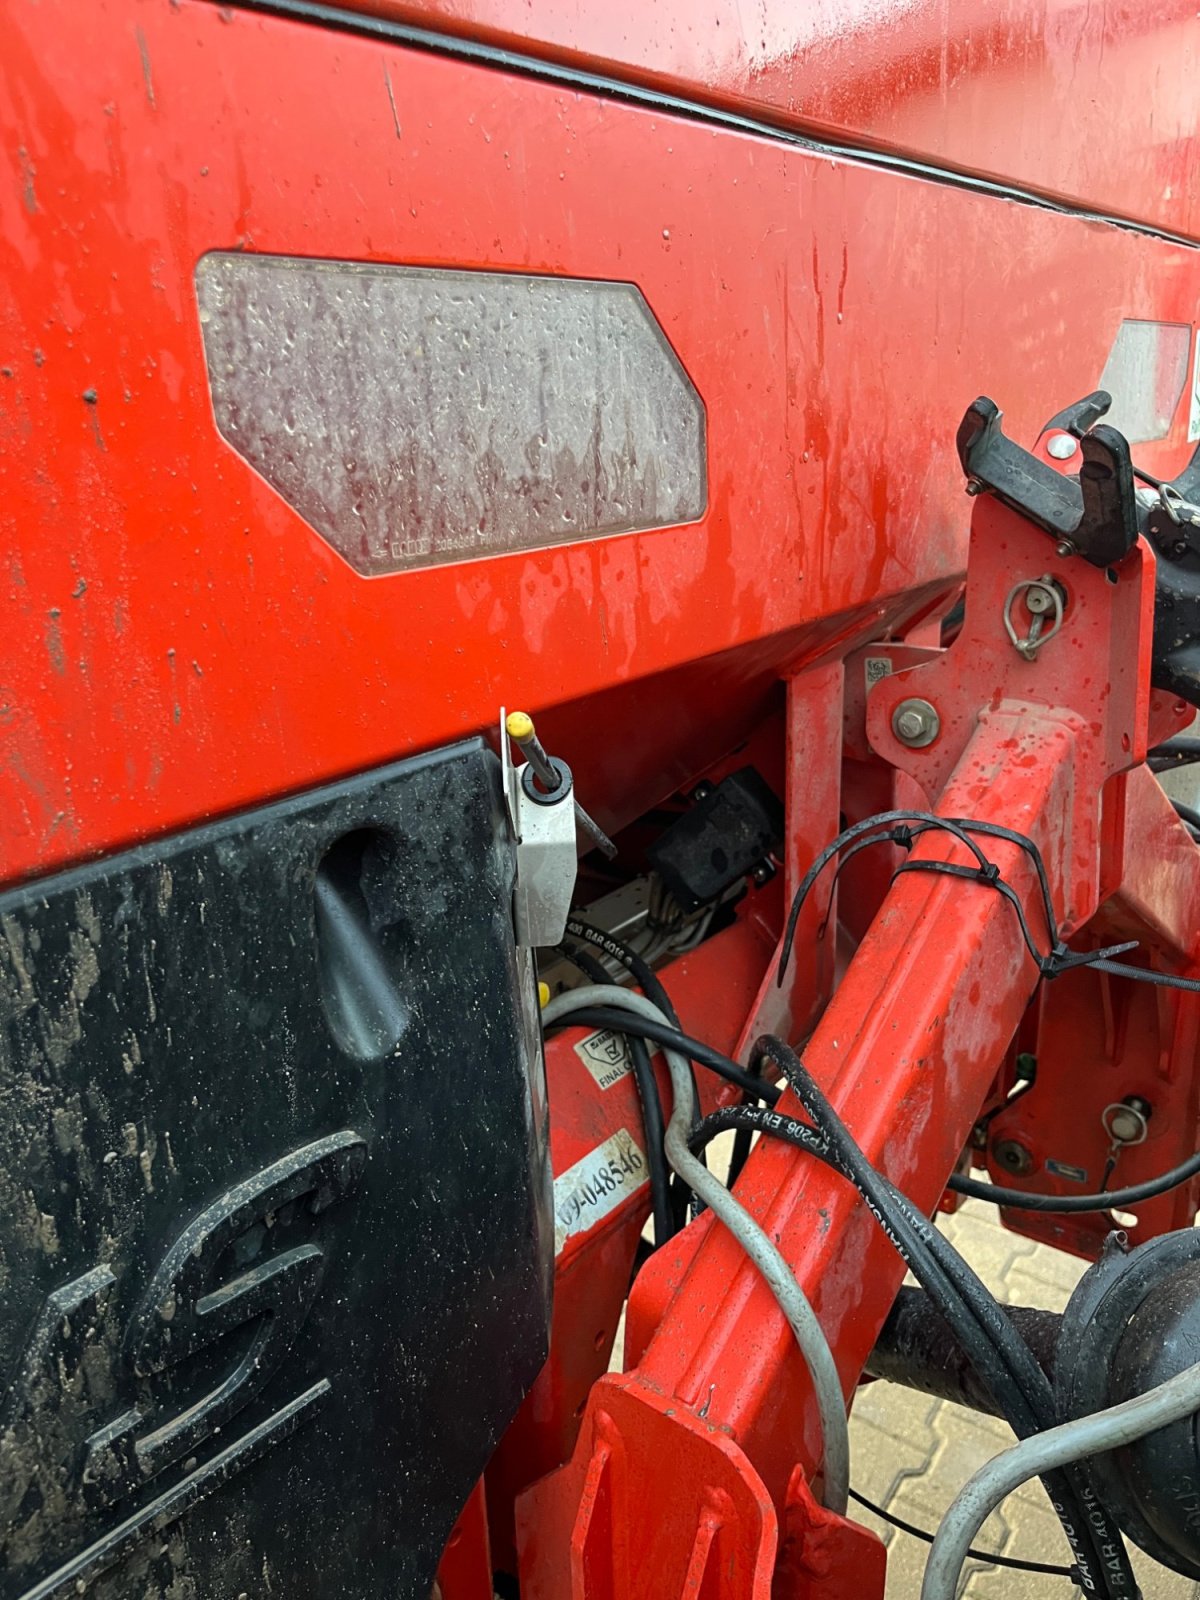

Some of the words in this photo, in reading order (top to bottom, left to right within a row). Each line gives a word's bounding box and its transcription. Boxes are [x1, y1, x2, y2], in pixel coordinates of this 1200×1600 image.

[585, 928, 605, 946] BAR
[599, 1067, 625, 1088] FINAL
[1101, 1543, 1126, 1586] BAR
